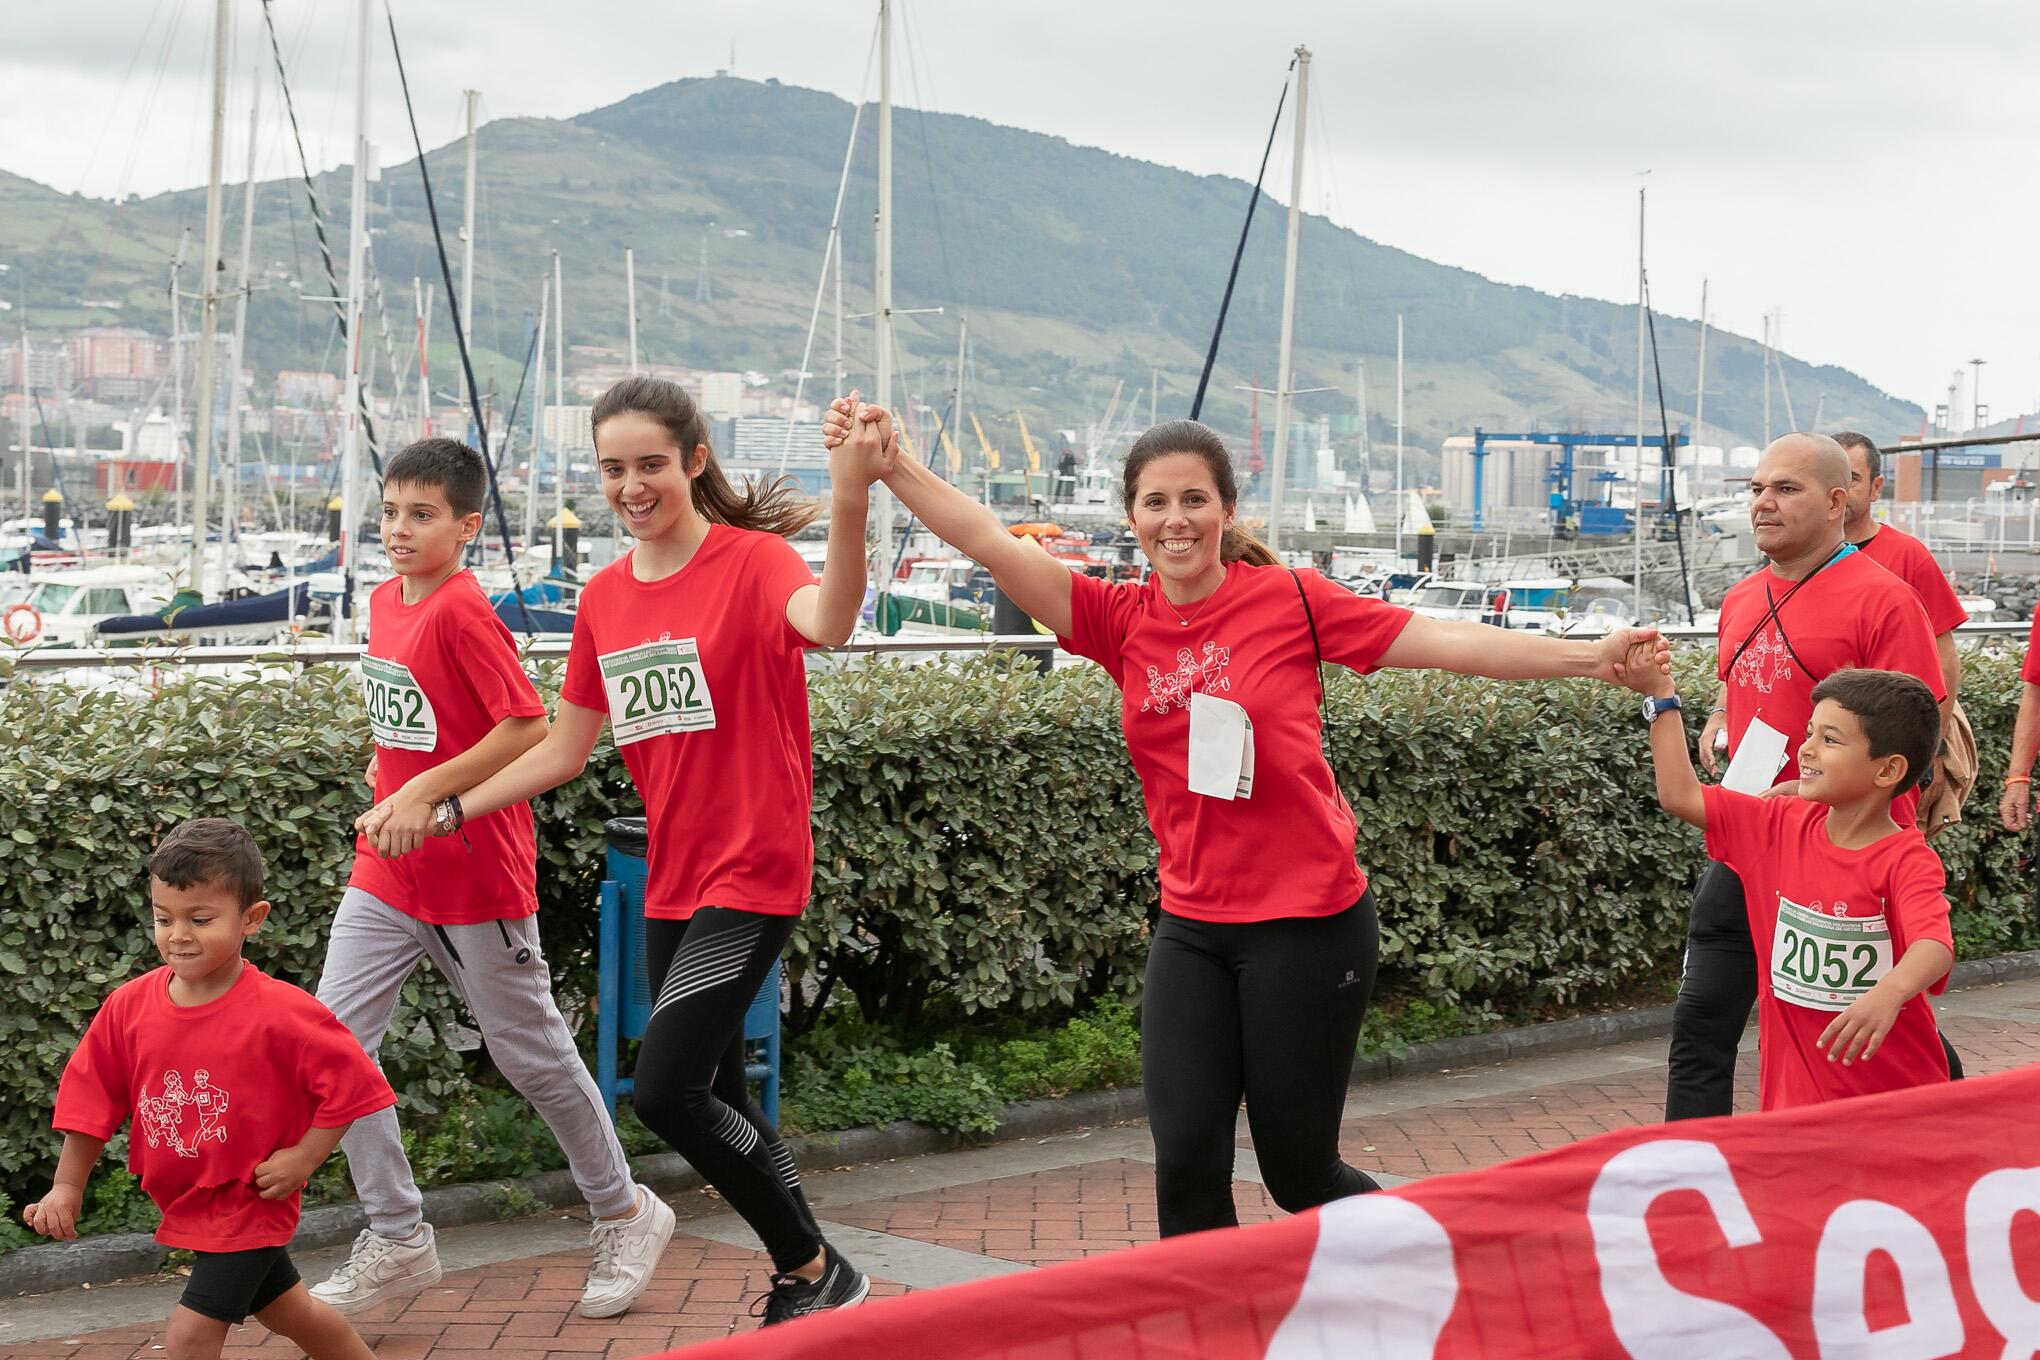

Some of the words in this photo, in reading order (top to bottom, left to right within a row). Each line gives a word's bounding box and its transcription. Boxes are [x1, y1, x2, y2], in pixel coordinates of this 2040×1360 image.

[367, 678, 426, 728] 2052
[621, 667, 702, 720] 2052
[1781, 929, 1878, 988] 2052
